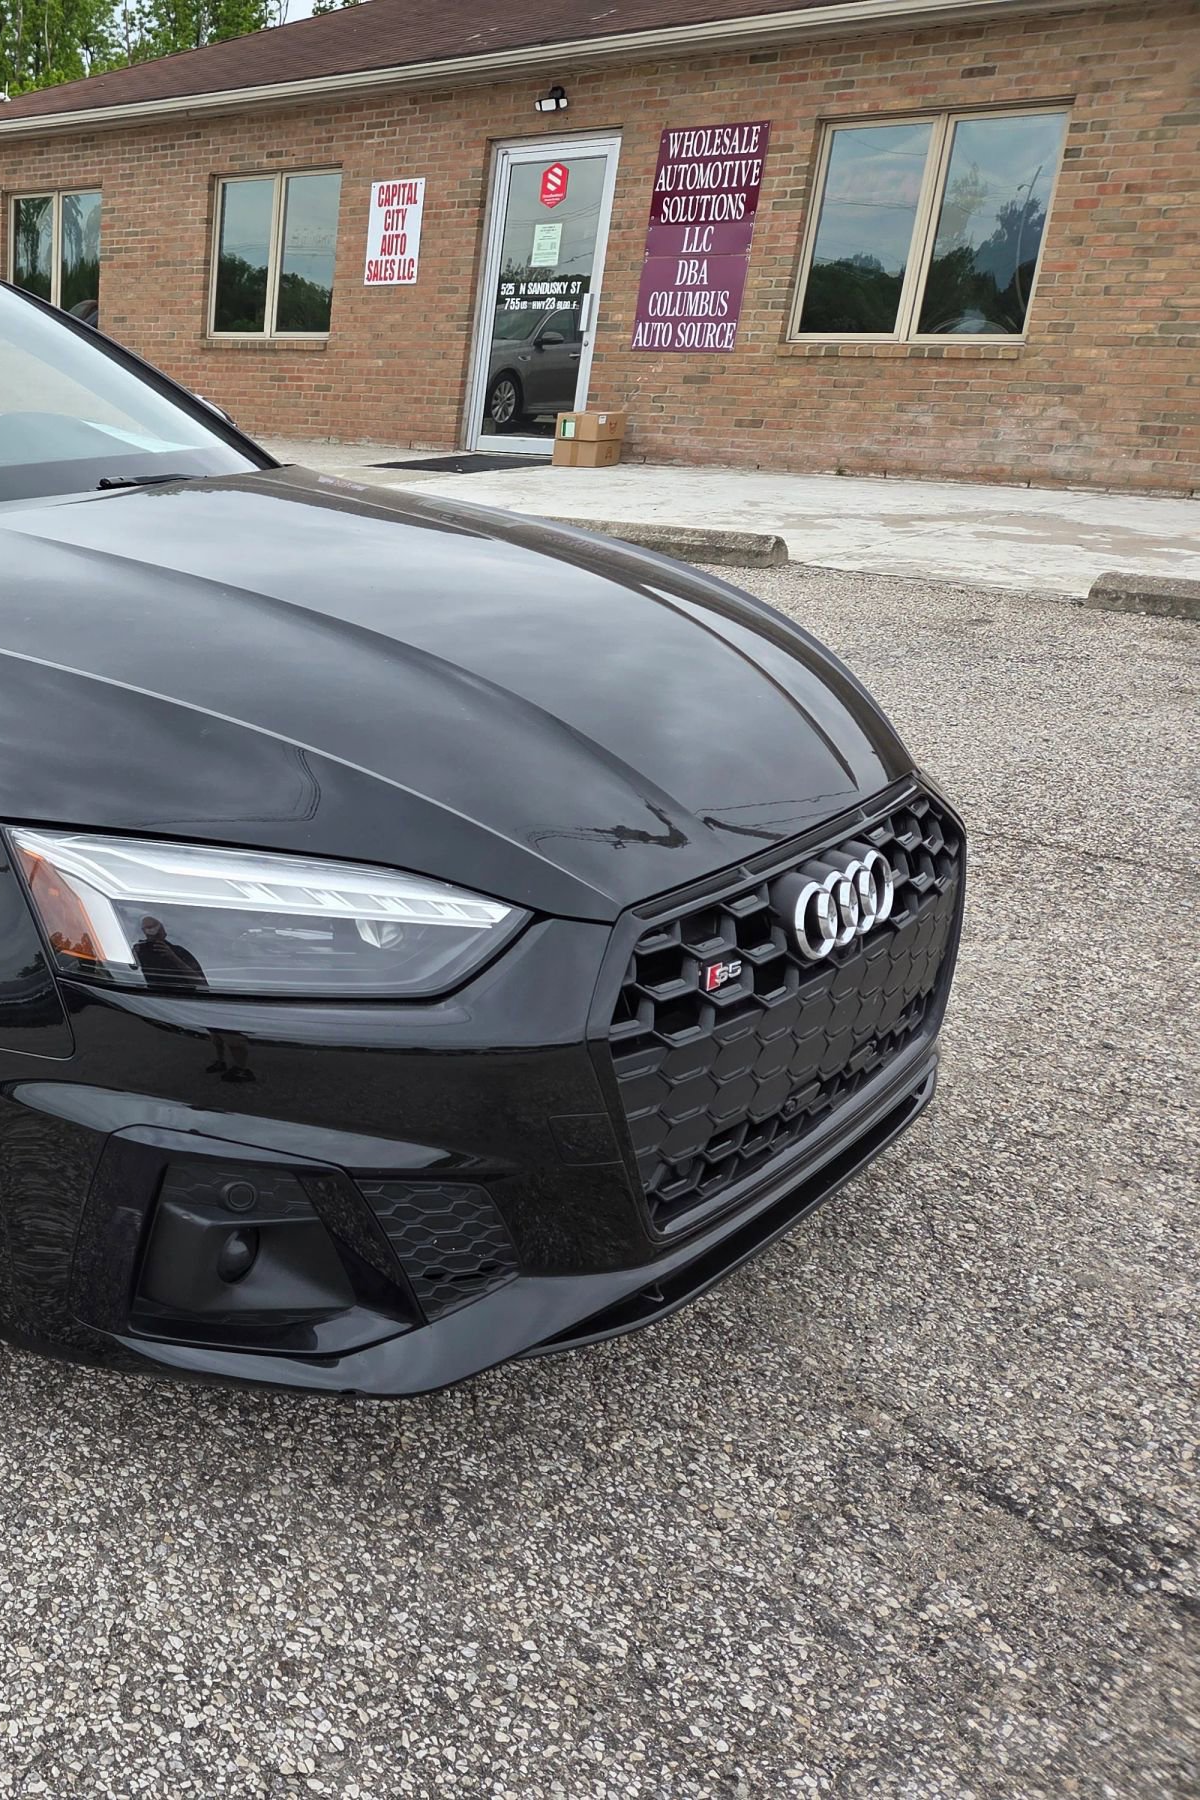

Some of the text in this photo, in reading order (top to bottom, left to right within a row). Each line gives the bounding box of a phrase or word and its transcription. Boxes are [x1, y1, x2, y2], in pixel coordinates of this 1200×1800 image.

[668, 126, 761, 159] WHOLESALE
[655, 159, 762, 191] AUTOMOTIVE
[377, 182, 418, 207] CAPITAL
[384, 208, 407, 231] CITY
[660, 193, 747, 223] SOLUTIONS
[380, 233, 407, 256] AUTO
[681, 226, 714, 253] LLC
[366, 258, 414, 282] SALES LLC
[675, 259, 709, 285] DBA
[519, 283, 526, 295] N
[527, 281, 568, 295] SANDUSKY
[570, 281, 582, 294] ST
[504, 298, 520, 310] 755
[648, 290, 730, 317] COLUMBUS
[632, 322, 737, 349] AUTO SOURCE
[714, 960, 742, 984] S5
